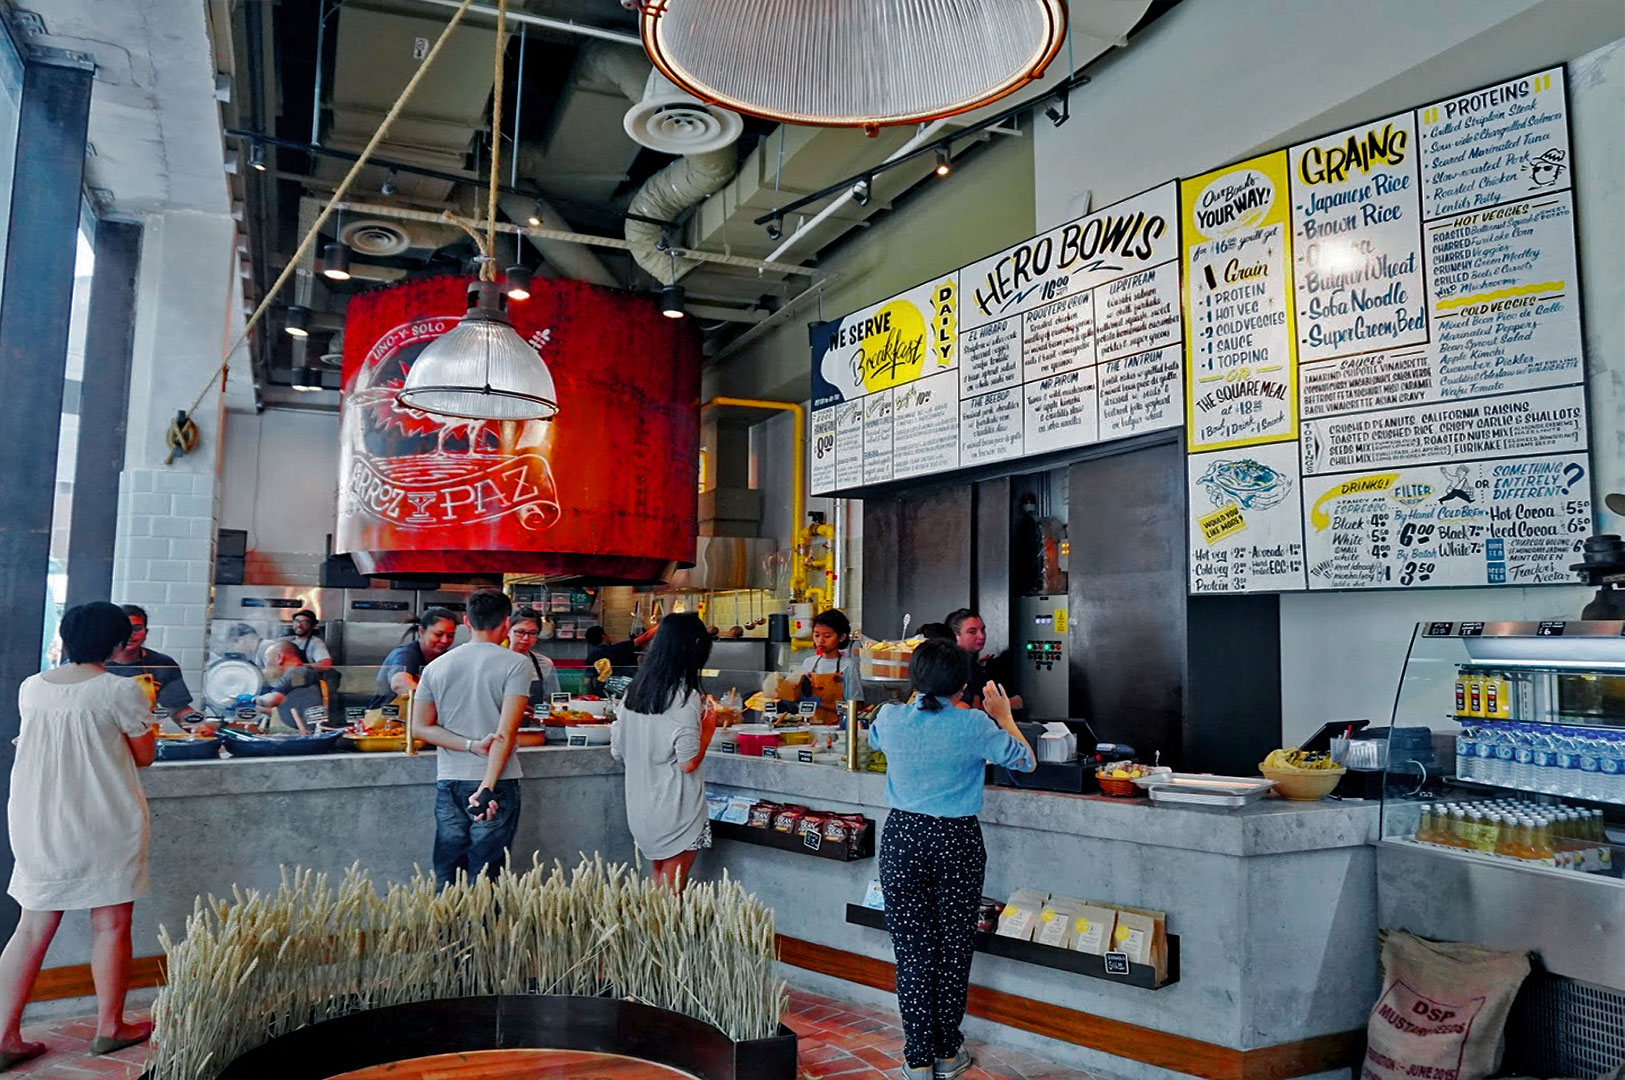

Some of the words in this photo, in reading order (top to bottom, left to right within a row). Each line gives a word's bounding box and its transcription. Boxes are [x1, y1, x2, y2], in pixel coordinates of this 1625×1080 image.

[1444, 80, 1529, 119] PROTEINS
[1508, 99, 1538, 117] Steak
[1527, 111, 1562, 126] Salmon
[1301, 123, 1407, 185] GRAINS
[1431, 153, 1465, 169] Seared
[1468, 136, 1521, 160] Marinated
[1523, 132, 1551, 145] Tuna
[1431, 160, 1502, 185] Slow-roasted
[1506, 150, 1532, 166] Pork
[1305, 185, 1372, 217] Japanese
[1371, 173, 1410, 196] Rice
[1434, 184, 1475, 200] Roasted
[1479, 171, 1518, 188] Chicken
[1197, 204, 1236, 229] YOUR
[1233, 187, 1271, 214] WAY!
[1435, 198, 1471, 216] Lentils
[1474, 190, 1504, 207] Patty
[1304, 215, 1356, 240] Brown
[1360, 203, 1402, 227] Rice
[1454, 214, 1478, 227] HOT
[1482, 204, 1530, 222] VEGGIES
[1433, 226, 1471, 243] ROASTED
[1433, 238, 1471, 254] CHARRED
[1512, 228, 1534, 238] Corn
[975, 237, 1053, 316] HERO
[1057, 212, 1165, 269] BOWLS
[1365, 252, 1418, 280] Wheat
[1433, 249, 1471, 265] CHARRED
[1433, 260, 1473, 275] CRUNCHY
[1474, 257, 1501, 268] Green
[1503, 248, 1540, 262] Medley
[1224, 258, 1269, 283] Grain
[1434, 272, 1469, 287] GRILLED
[1110, 270, 1155, 295] UPSTREAM
[1434, 284, 1457, 298] WILD
[1460, 278, 1516, 294] Mushrooms
[1215, 282, 1265, 304] PROTEIN
[1309, 294, 1350, 320] Soba
[1351, 282, 1408, 312] Noodle
[1216, 305, 1235, 320] HOT
[1237, 301, 1259, 316] VEG
[1438, 318, 1469, 331] Mixed
[1472, 315, 1494, 326] Bean
[1497, 311, 1517, 323] Pico
[1519, 309, 1532, 318] de
[1535, 301, 1564, 315] Gallo
[1460, 304, 1488, 317] COLD
[1490, 296, 1537, 312] VEGGIES
[829, 330, 847, 351] WE
[850, 311, 892, 345] SERVE
[939, 287, 952, 358] DAILY
[1216, 320, 1243, 336] COLD
[1243, 311, 1285, 331] VEGGIES
[1308, 323, 1354, 349] Super
[1395, 306, 1425, 332] Bed
[1438, 326, 1492, 342] Marinated
[1495, 320, 1539, 334] Peppers
[1216, 334, 1253, 352] SAUCE
[1439, 341, 1464, 353] Bean
[1464, 337, 1498, 352] Sprout
[1500, 331, 1533, 344] Salad
[849, 327, 923, 387] Breakfast
[1106, 360, 1120, 373] THE
[1124, 351, 1163, 369] TANTRUM
[1217, 348, 1268, 368] TOPPING
[1439, 354, 1466, 367] Apple
[1470, 347, 1505, 360] Kimchi
[1439, 362, 1491, 375] Cucumber
[1495, 355, 1535, 367] Pickles
[1225, 367, 1251, 382] OR
[1196, 392, 1217, 413] THE
[1216, 380, 1260, 403] SQUARE
[1260, 381, 1287, 400] MEAL
[1441, 386, 1467, 399] Wafu
[1469, 382, 1504, 393] Tomato
[1221, 405, 1232, 415] at
[1262, 410, 1284, 430] Snack
[1329, 421, 1371, 435] CRUSHED
[1421, 406, 1480, 424] CALIFORNIA
[1329, 432, 1370, 445] TOASTED
[1372, 427, 1411, 440] CRUSHED
[1440, 420, 1473, 433] CRISPY
[1477, 415, 1513, 429] GARLIC
[1515, 415, 1523, 424] &
[1329, 444, 1354, 456] SEEDS
[1424, 432, 1466, 445] ROASTED
[1467, 430, 1490, 441] NUTS
[1454, 440, 1501, 454] FURIKAKE
[1492, 462, 1563, 477] SOMETHING
[352, 462, 405, 518] ARROZ
[406, 491, 437, 522] Y
[440, 464, 539, 520] PAZ
[1341, 478, 1390, 494] DRINKS!
[1394, 484, 1432, 497] FILTER
[1475, 480, 1490, 489] OR
[1494, 475, 1559, 489] ENTIRELY
[1493, 486, 1562, 500] DIFFERENT
[1203, 515, 1226, 529] WOULD
[1225, 507, 1239, 518] YOU
[1394, 510, 1407, 525] By
[1408, 507, 1435, 519] Hand
[1437, 507, 1461, 519] COLD
[1490, 506, 1512, 521] Hot
[1515, 504, 1555, 519] Cocoa
[1206, 525, 1221, 538] LIKE
[1332, 516, 1365, 530] Black
[1438, 525, 1469, 540] Black
[1490, 521, 1517, 538] Iced
[1518, 521, 1557, 538] Cocoa
[1332, 533, 1363, 545] White
[1439, 541, 1470, 557] White
[1195, 549, 1209, 561] Hot
[1396, 549, 1408, 562] By
[1411, 548, 1437, 559] Batch
[1195, 563, 1214, 576] Cold
[1196, 578, 1229, 591] Protein
[1412, 1000, 1456, 1022] DSP
[1407, 1064, 1433, 1079] JUNE
